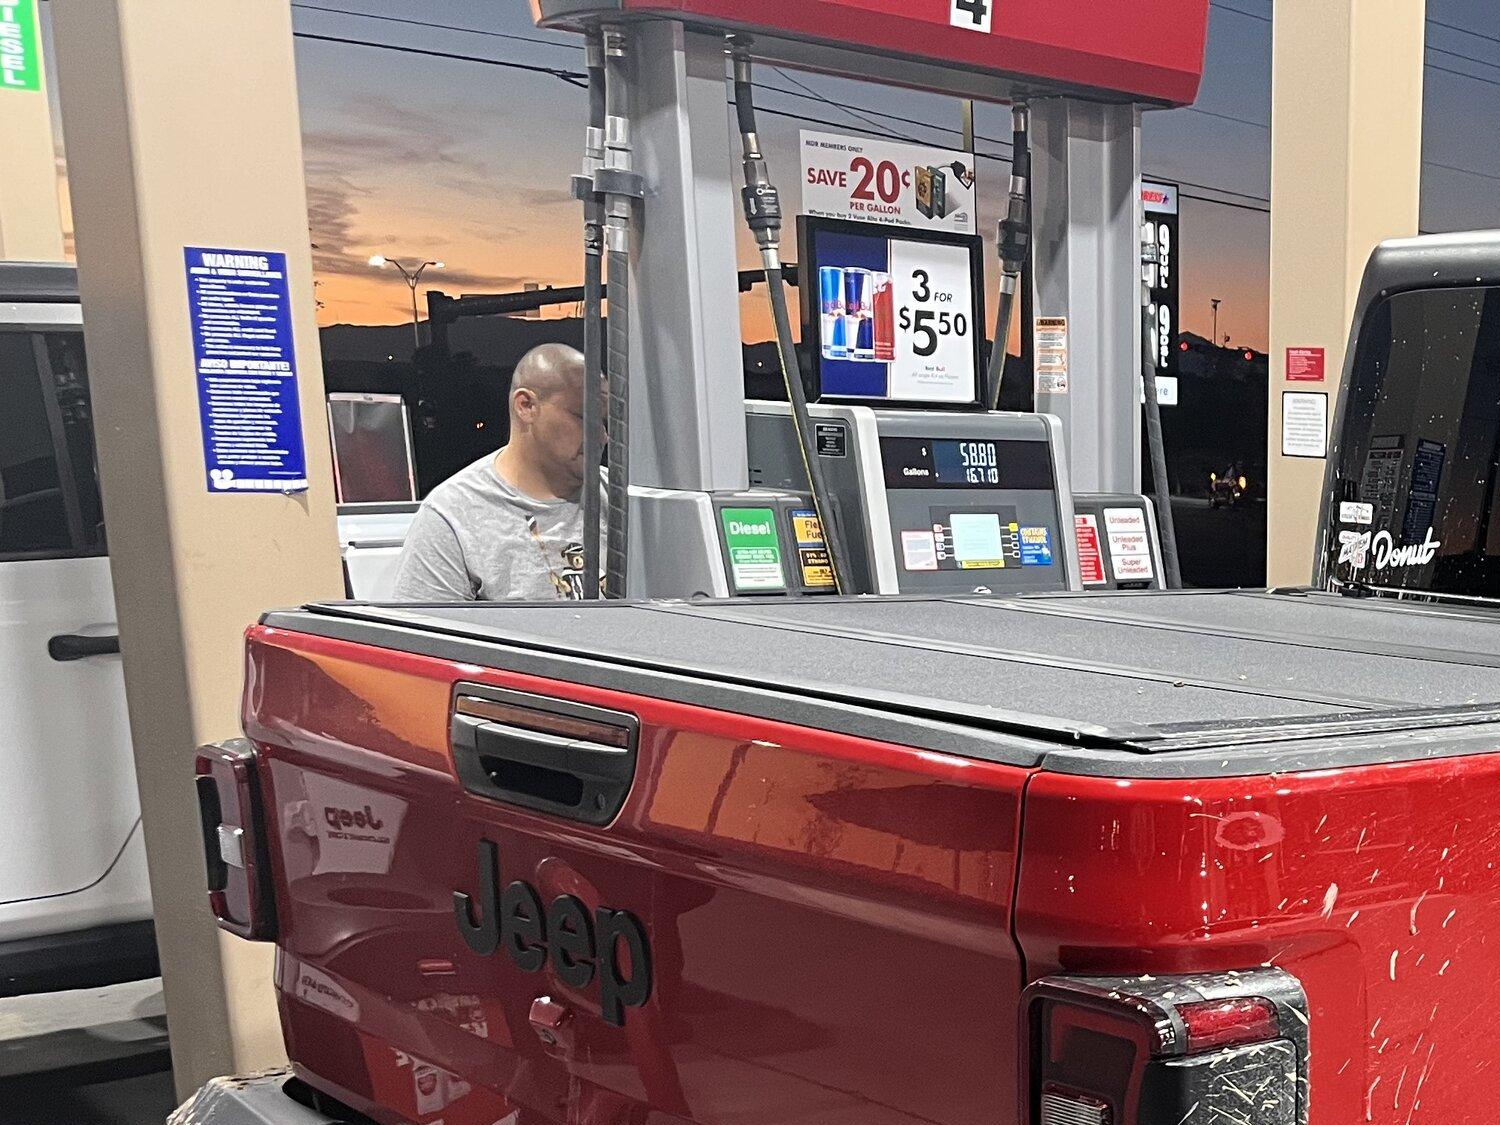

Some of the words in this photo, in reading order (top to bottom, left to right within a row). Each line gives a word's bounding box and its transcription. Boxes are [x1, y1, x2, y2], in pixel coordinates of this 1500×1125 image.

[0, 0, 27, 87] IESEL
[807, 167, 847, 187] SAVE
[850, 202, 865, 211] PER
[867, 203, 901, 215] GALLON
[201, 253, 269, 271] WARNING
[912, 269, 931, 303] 3
[934, 292, 953, 303] FOR
[903, 467, 930, 477] Gallons
[804, 520, 819, 529] Fle
[1109, 516, 1140, 524] Unleaded
[729, 521, 771, 535] Diesel
[806, 530, 823, 539] Fue
[1112, 536, 1143, 544] Unleaded
[1371, 526, 1441, 570] Donut
[1121, 559, 1141, 567] Super
[1118, 566, 1149, 575] Unleaded
[452, 836, 653, 1028] Jeep
